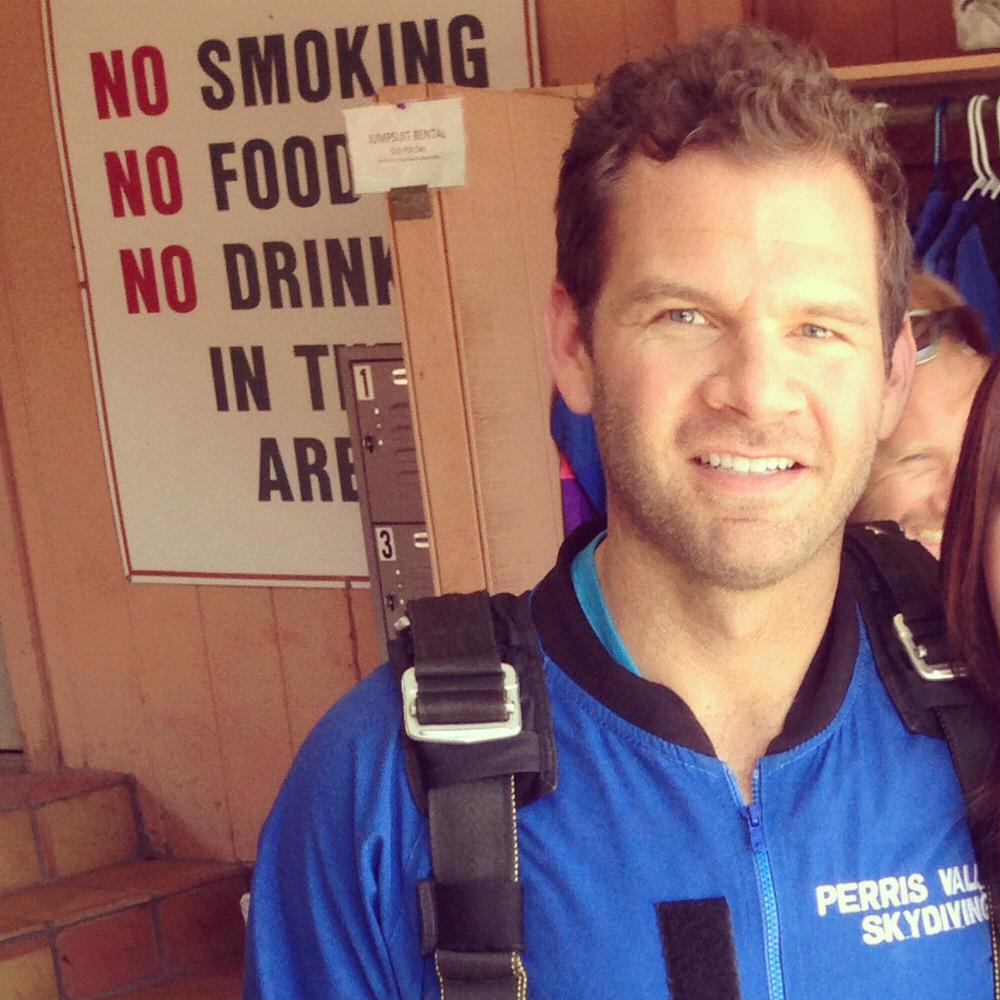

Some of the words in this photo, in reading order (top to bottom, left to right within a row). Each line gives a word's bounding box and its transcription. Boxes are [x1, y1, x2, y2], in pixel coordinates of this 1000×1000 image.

[89, 45, 169, 120] NO
[197, 14, 489, 111] SMOKING
[104, 145, 183, 218] NO
[208, 133, 360, 211] FOOD
[119, 244, 198, 314] NO
[209, 345, 271, 412] IN
[359, 368, 370, 398] 1
[379, 530, 393, 559] 3
[815, 873, 928, 917] PERRIS
